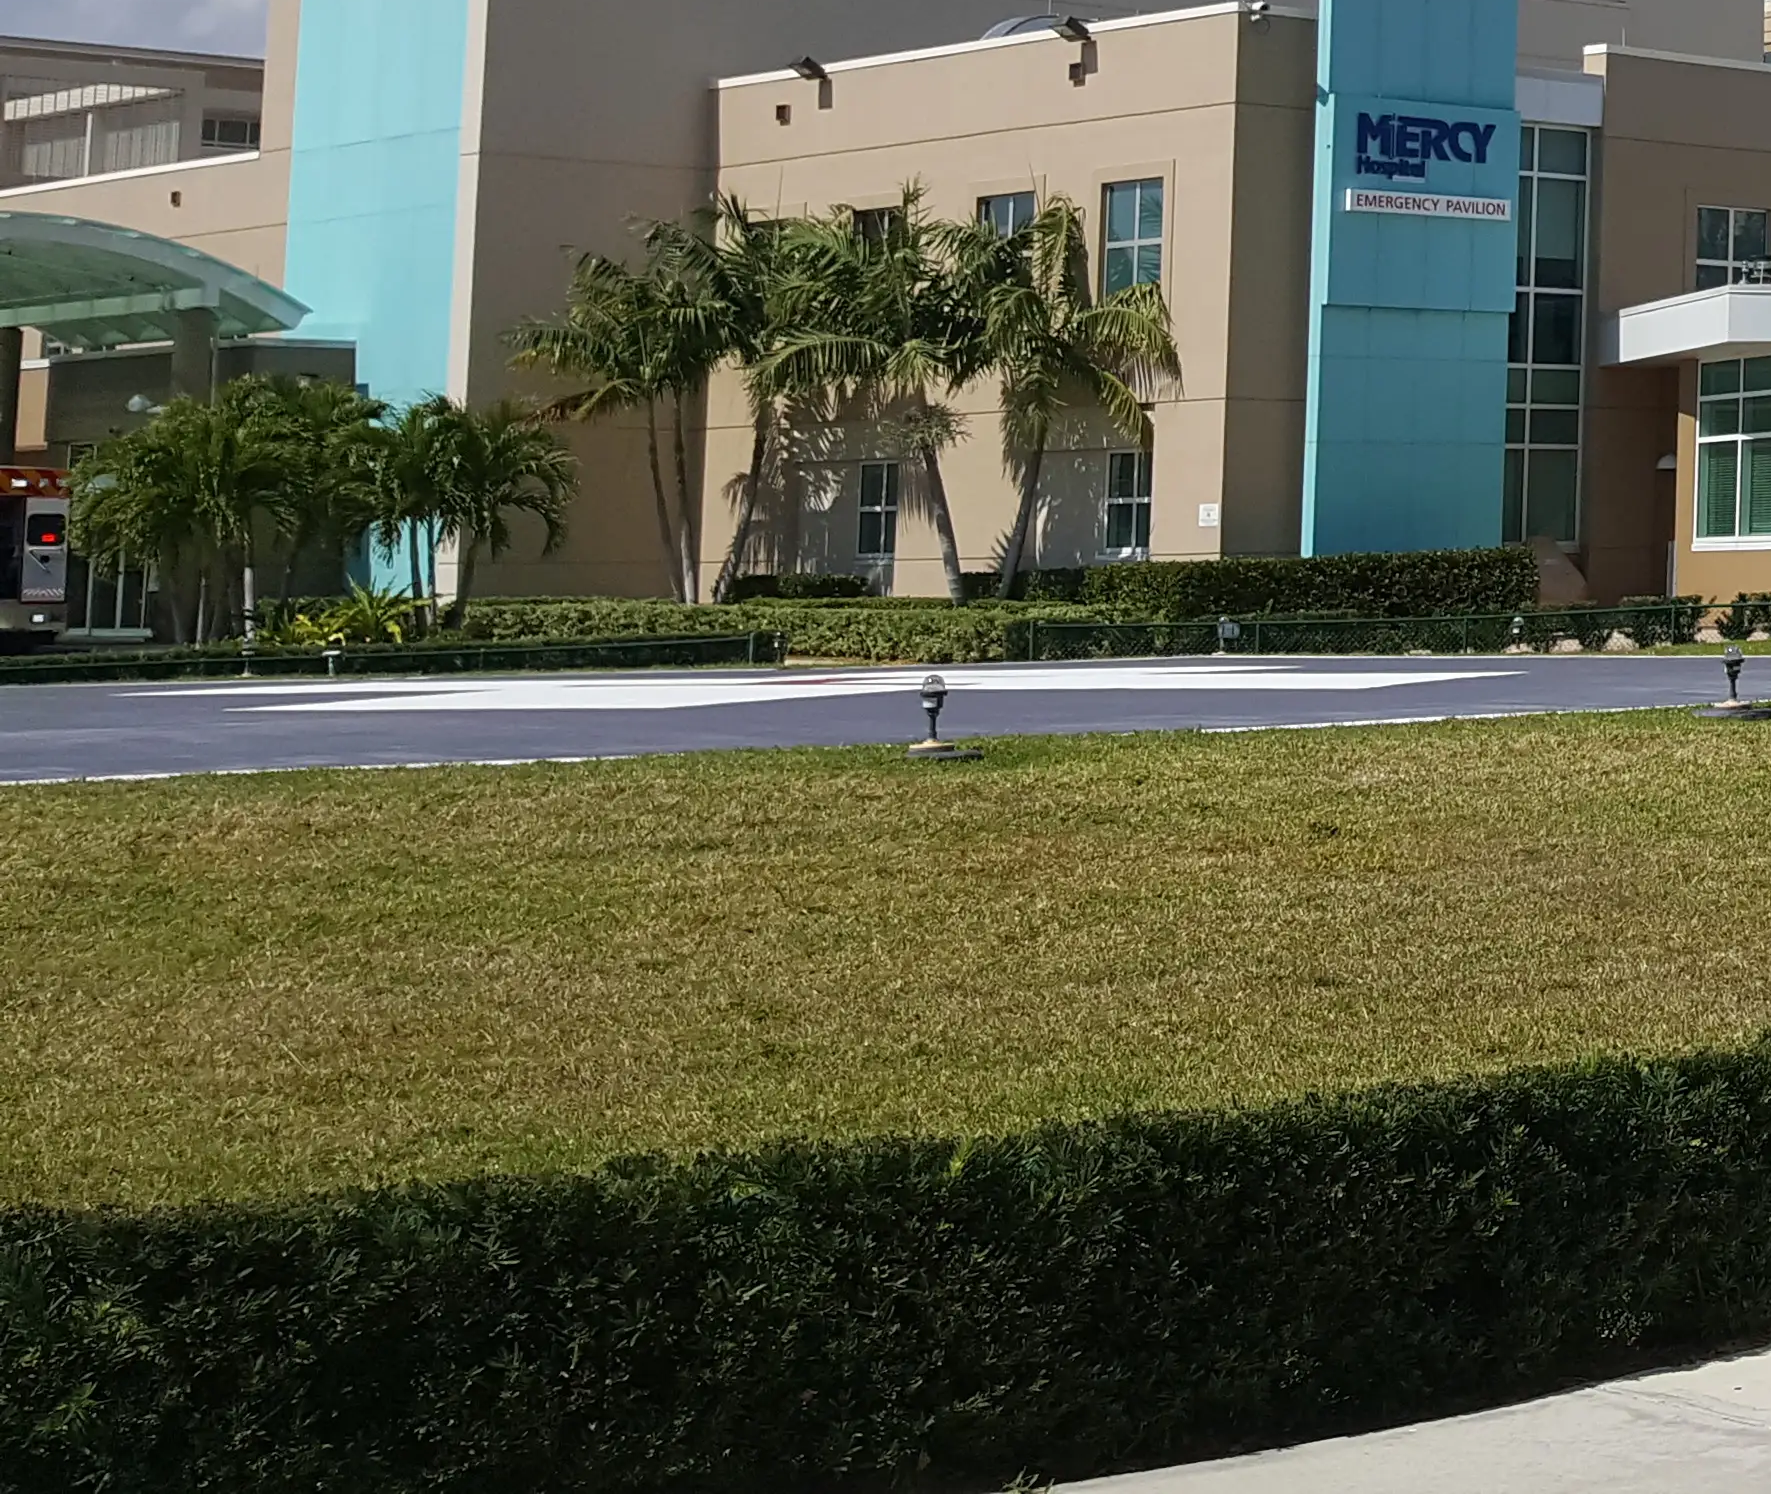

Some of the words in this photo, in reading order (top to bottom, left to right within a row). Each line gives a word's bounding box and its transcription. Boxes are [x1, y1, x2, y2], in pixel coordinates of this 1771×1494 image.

[1357, 112, 1497, 164] MERCY
[1356, 155, 1426, 180] Hospital
[1356, 193, 1440, 212] EMERGENCY
[1446, 199, 1506, 216] PAVILION
